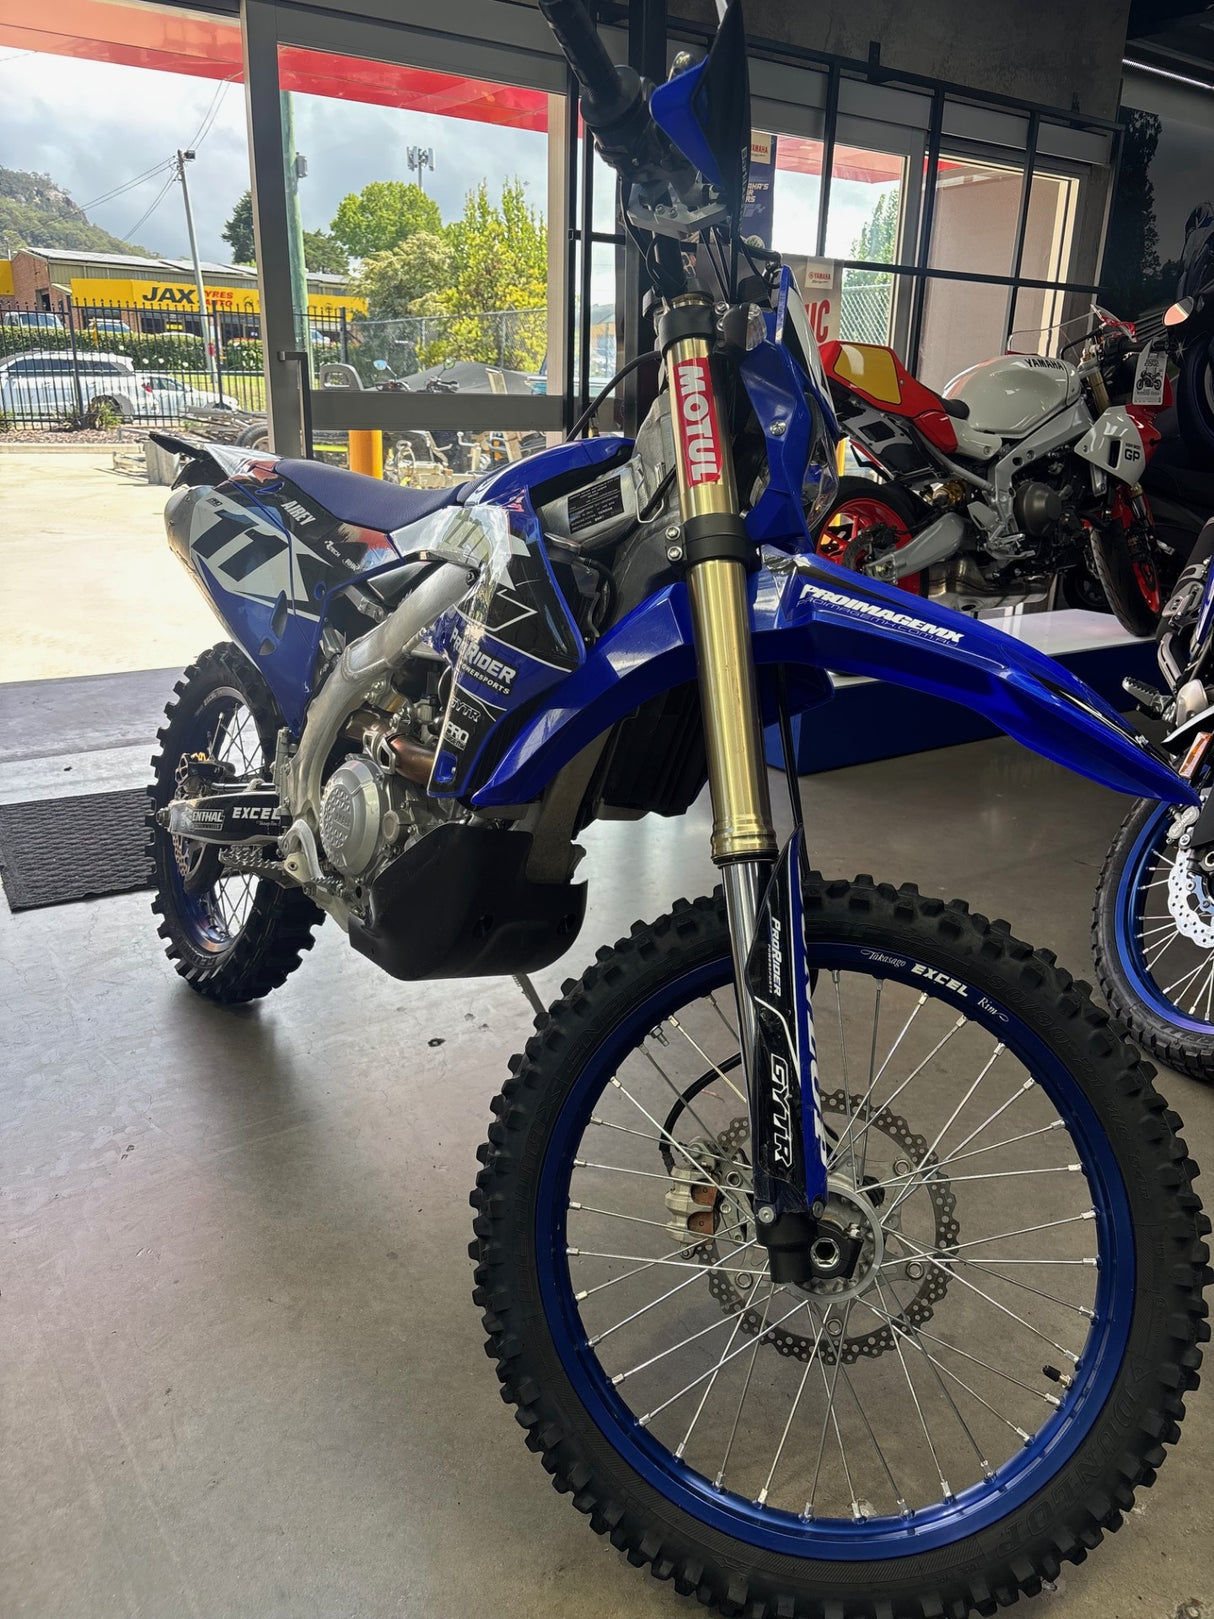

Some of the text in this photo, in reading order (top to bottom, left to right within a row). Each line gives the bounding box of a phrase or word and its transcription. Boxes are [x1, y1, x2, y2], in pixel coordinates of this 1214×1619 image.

[751, 144, 768, 153] AMAHA
[814, 272, 831, 280] YAMAHA
[142, 286, 196, 304] JAX
[204, 290, 234, 299] YRES
[205, 299, 233, 307] ATO
[1024, 358, 1065, 371] YAMAHA
[678, 365, 718, 481] MOTUL
[1124, 449, 1141, 462] GP
[280, 500, 317, 526] AIREY
[190, 509, 289, 582] 11
[800, 583, 965, 643] PROIMAGEMX
[450, 627, 517, 684] PRRIDER
[461, 662, 511, 695] OWERSPORTS
[232, 806, 281, 821] EXCEL
[861, 949, 1010, 1023] Takasago EXCEL Rim
[770, 1053, 793, 1168] GYTR
